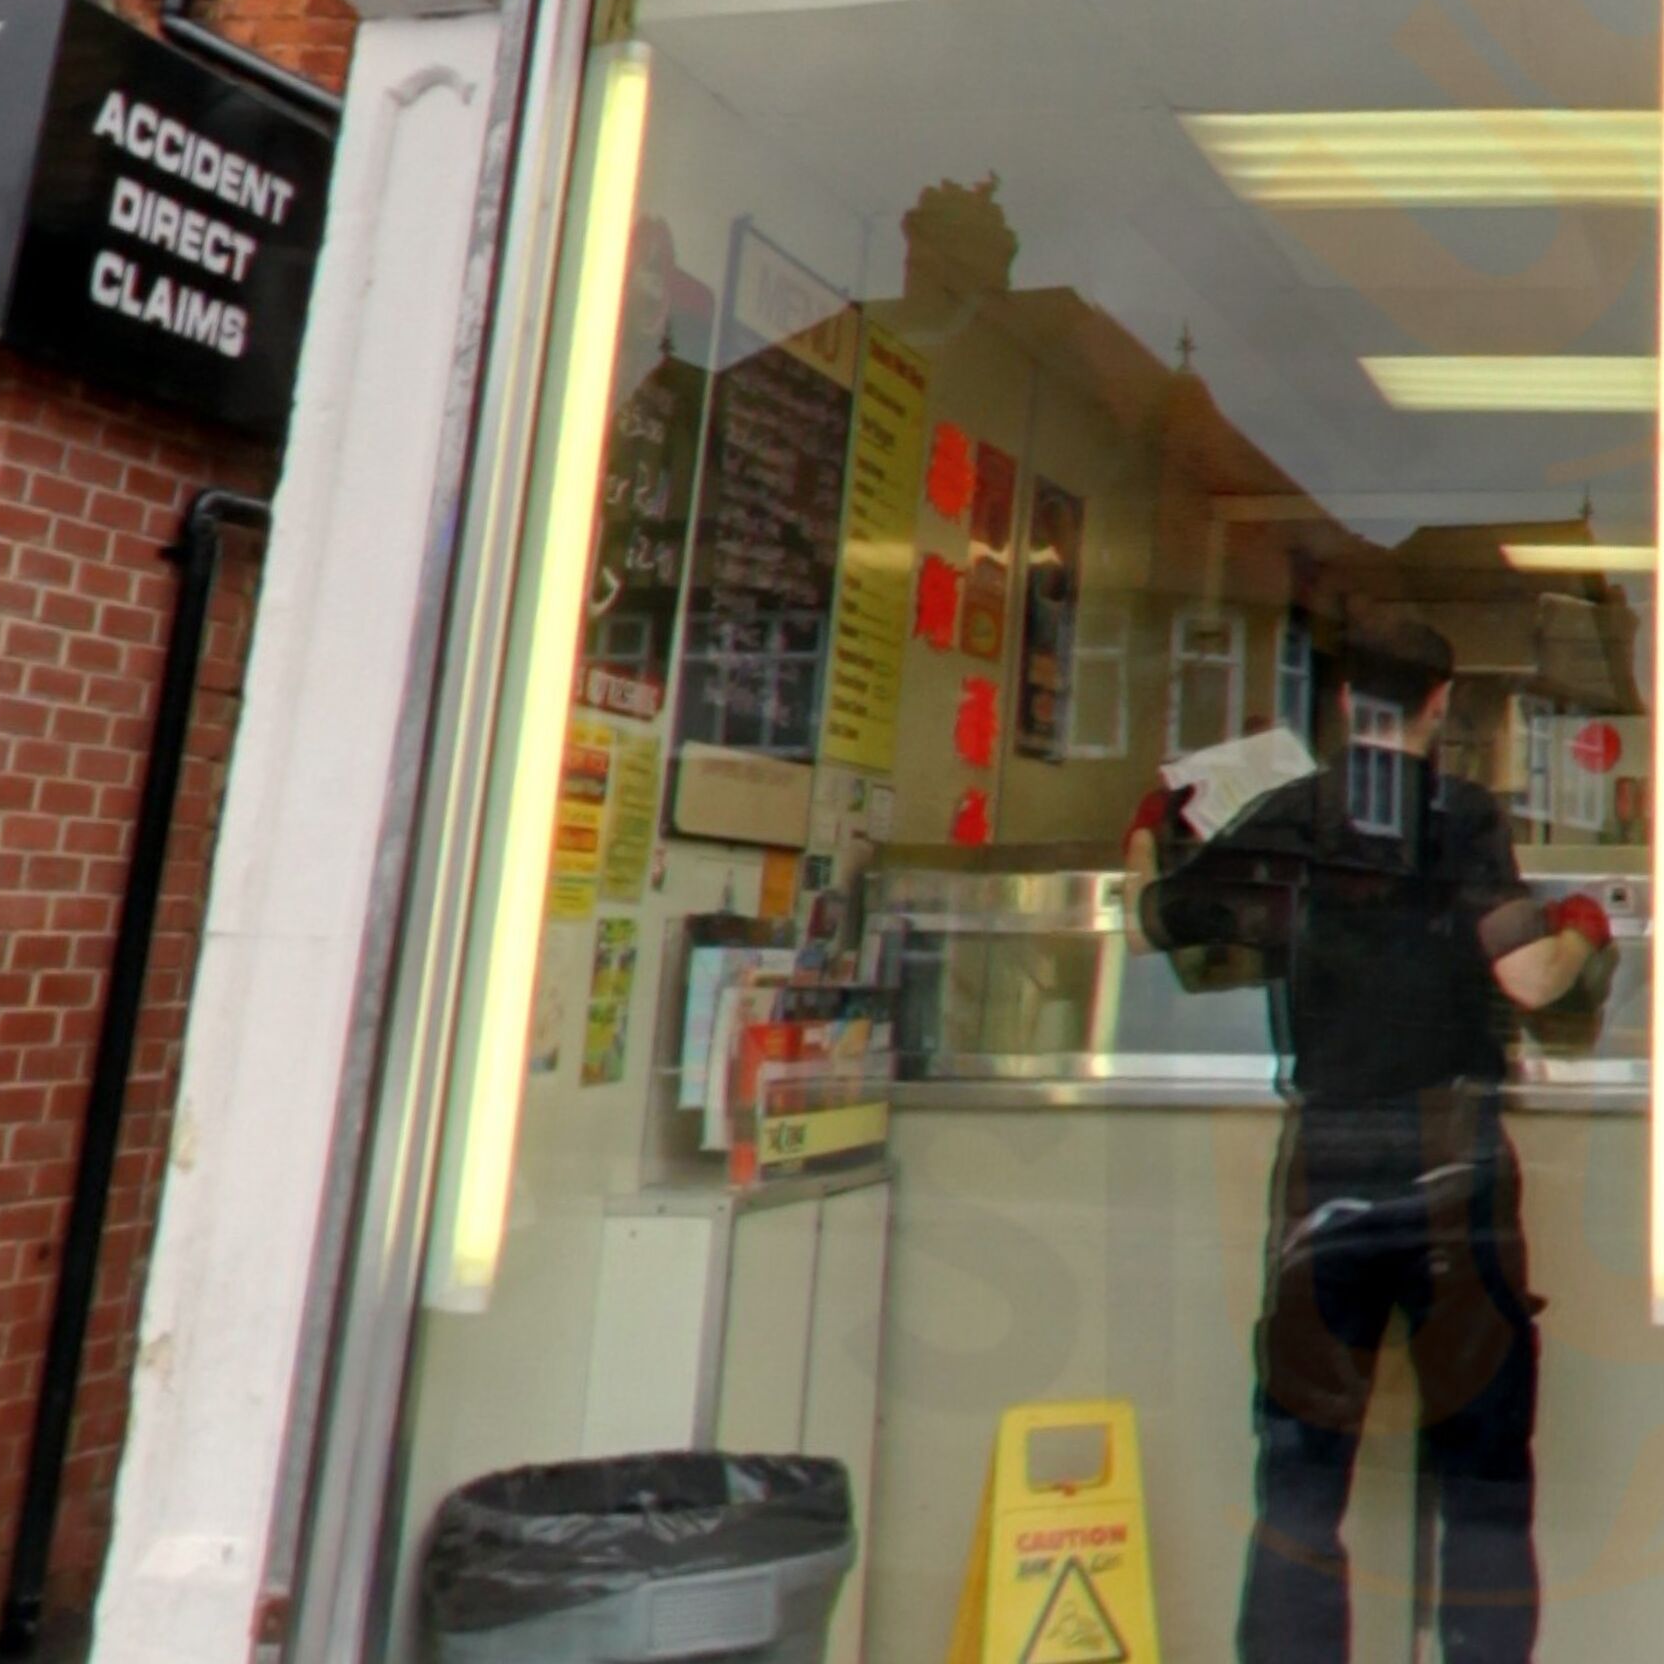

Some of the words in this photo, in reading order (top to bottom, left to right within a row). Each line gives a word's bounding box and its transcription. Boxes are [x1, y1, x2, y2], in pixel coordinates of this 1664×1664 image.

[92, 89, 294, 226] ACCIDENT
[108, 176, 258, 283] DIRECT
[90, 249, 248, 358] CLAIMS
[1016, 1523, 1127, 1553] CAUTION
